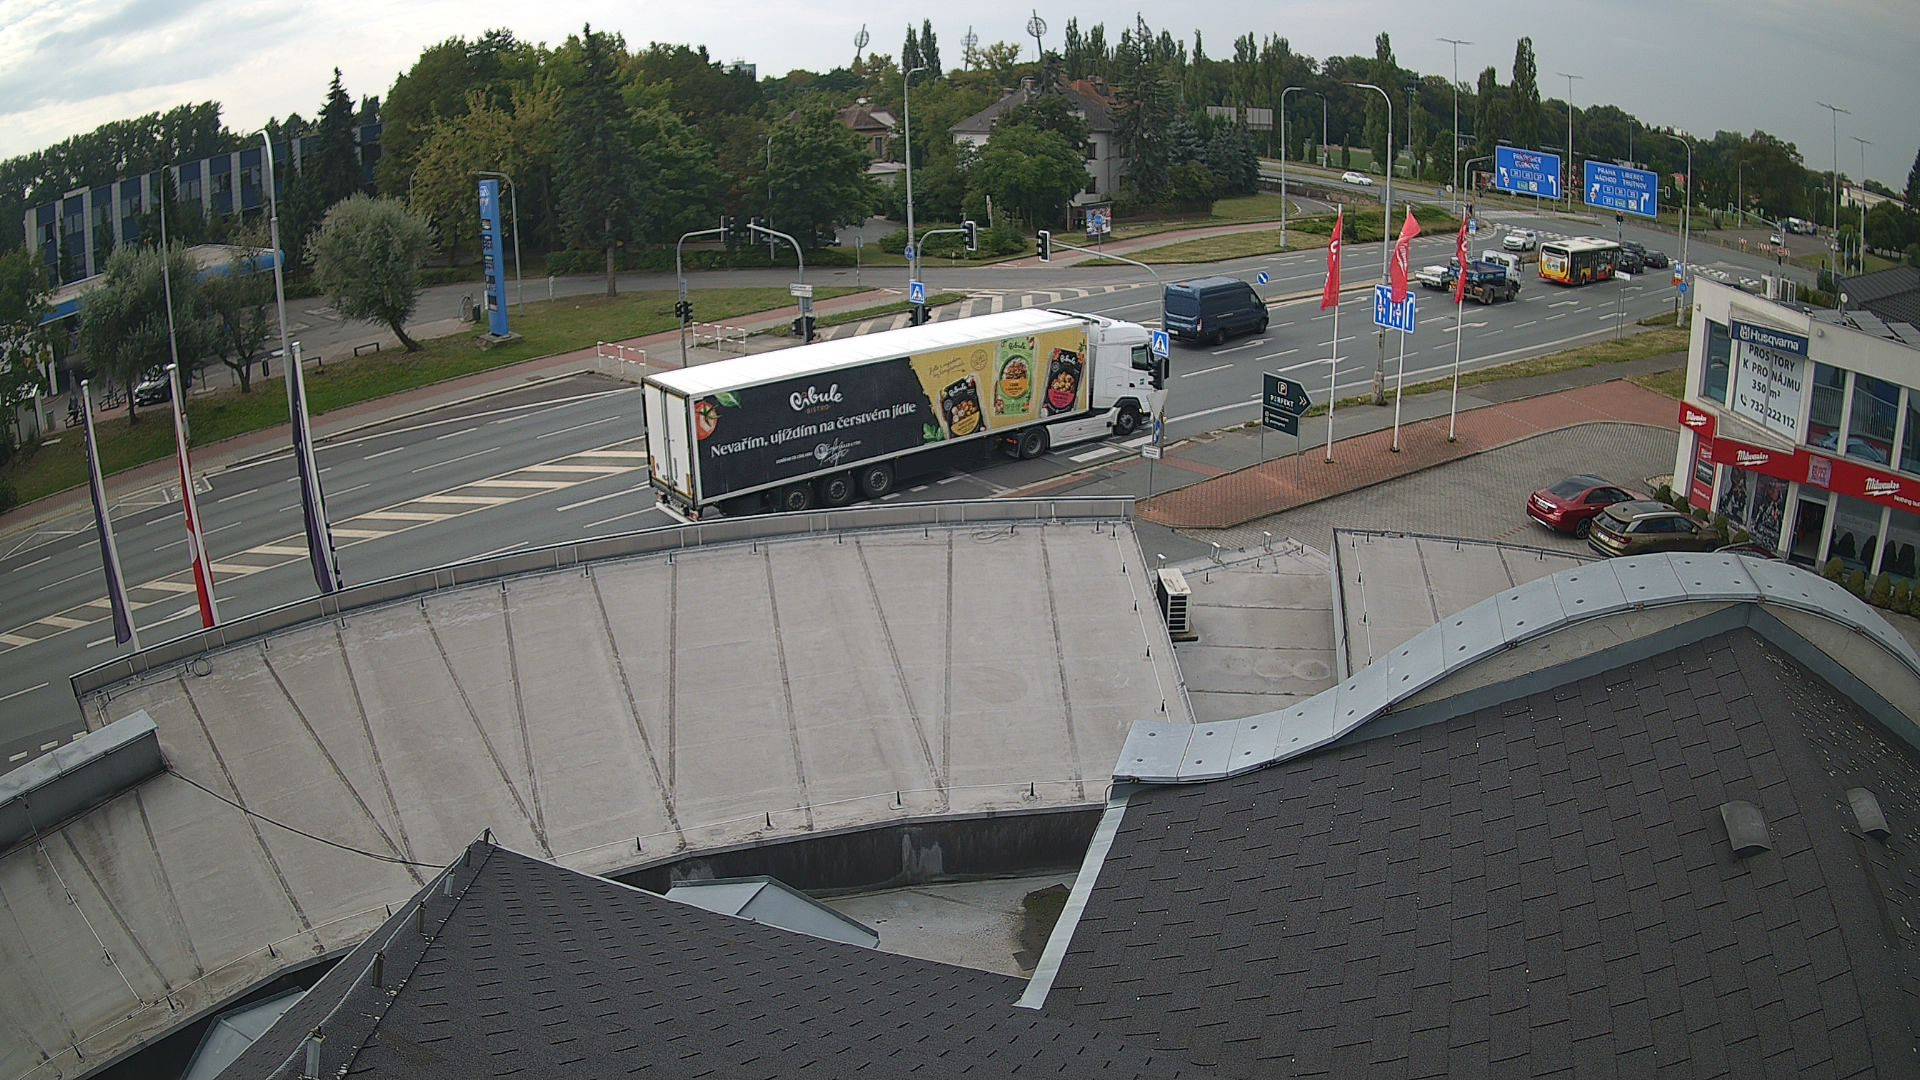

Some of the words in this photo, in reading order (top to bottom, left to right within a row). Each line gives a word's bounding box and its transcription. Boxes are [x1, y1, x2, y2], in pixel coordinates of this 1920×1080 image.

[1750, 328, 1800, 352] Husqvarna
[1743, 357, 1749, 370] K
[1751, 379, 1767, 394] 350
[789, 383, 844, 411] Cibule
[1750, 399, 1765, 414] 732
[709, 434, 769, 459] Nevařím,
[770, 424, 818, 446] ujíždím
[819, 420, 836, 433] na
[836, 409, 891, 430] čerstvém
[891, 402, 917, 418] jídle
[1864, 477, 1900, 491] Milwaukee
